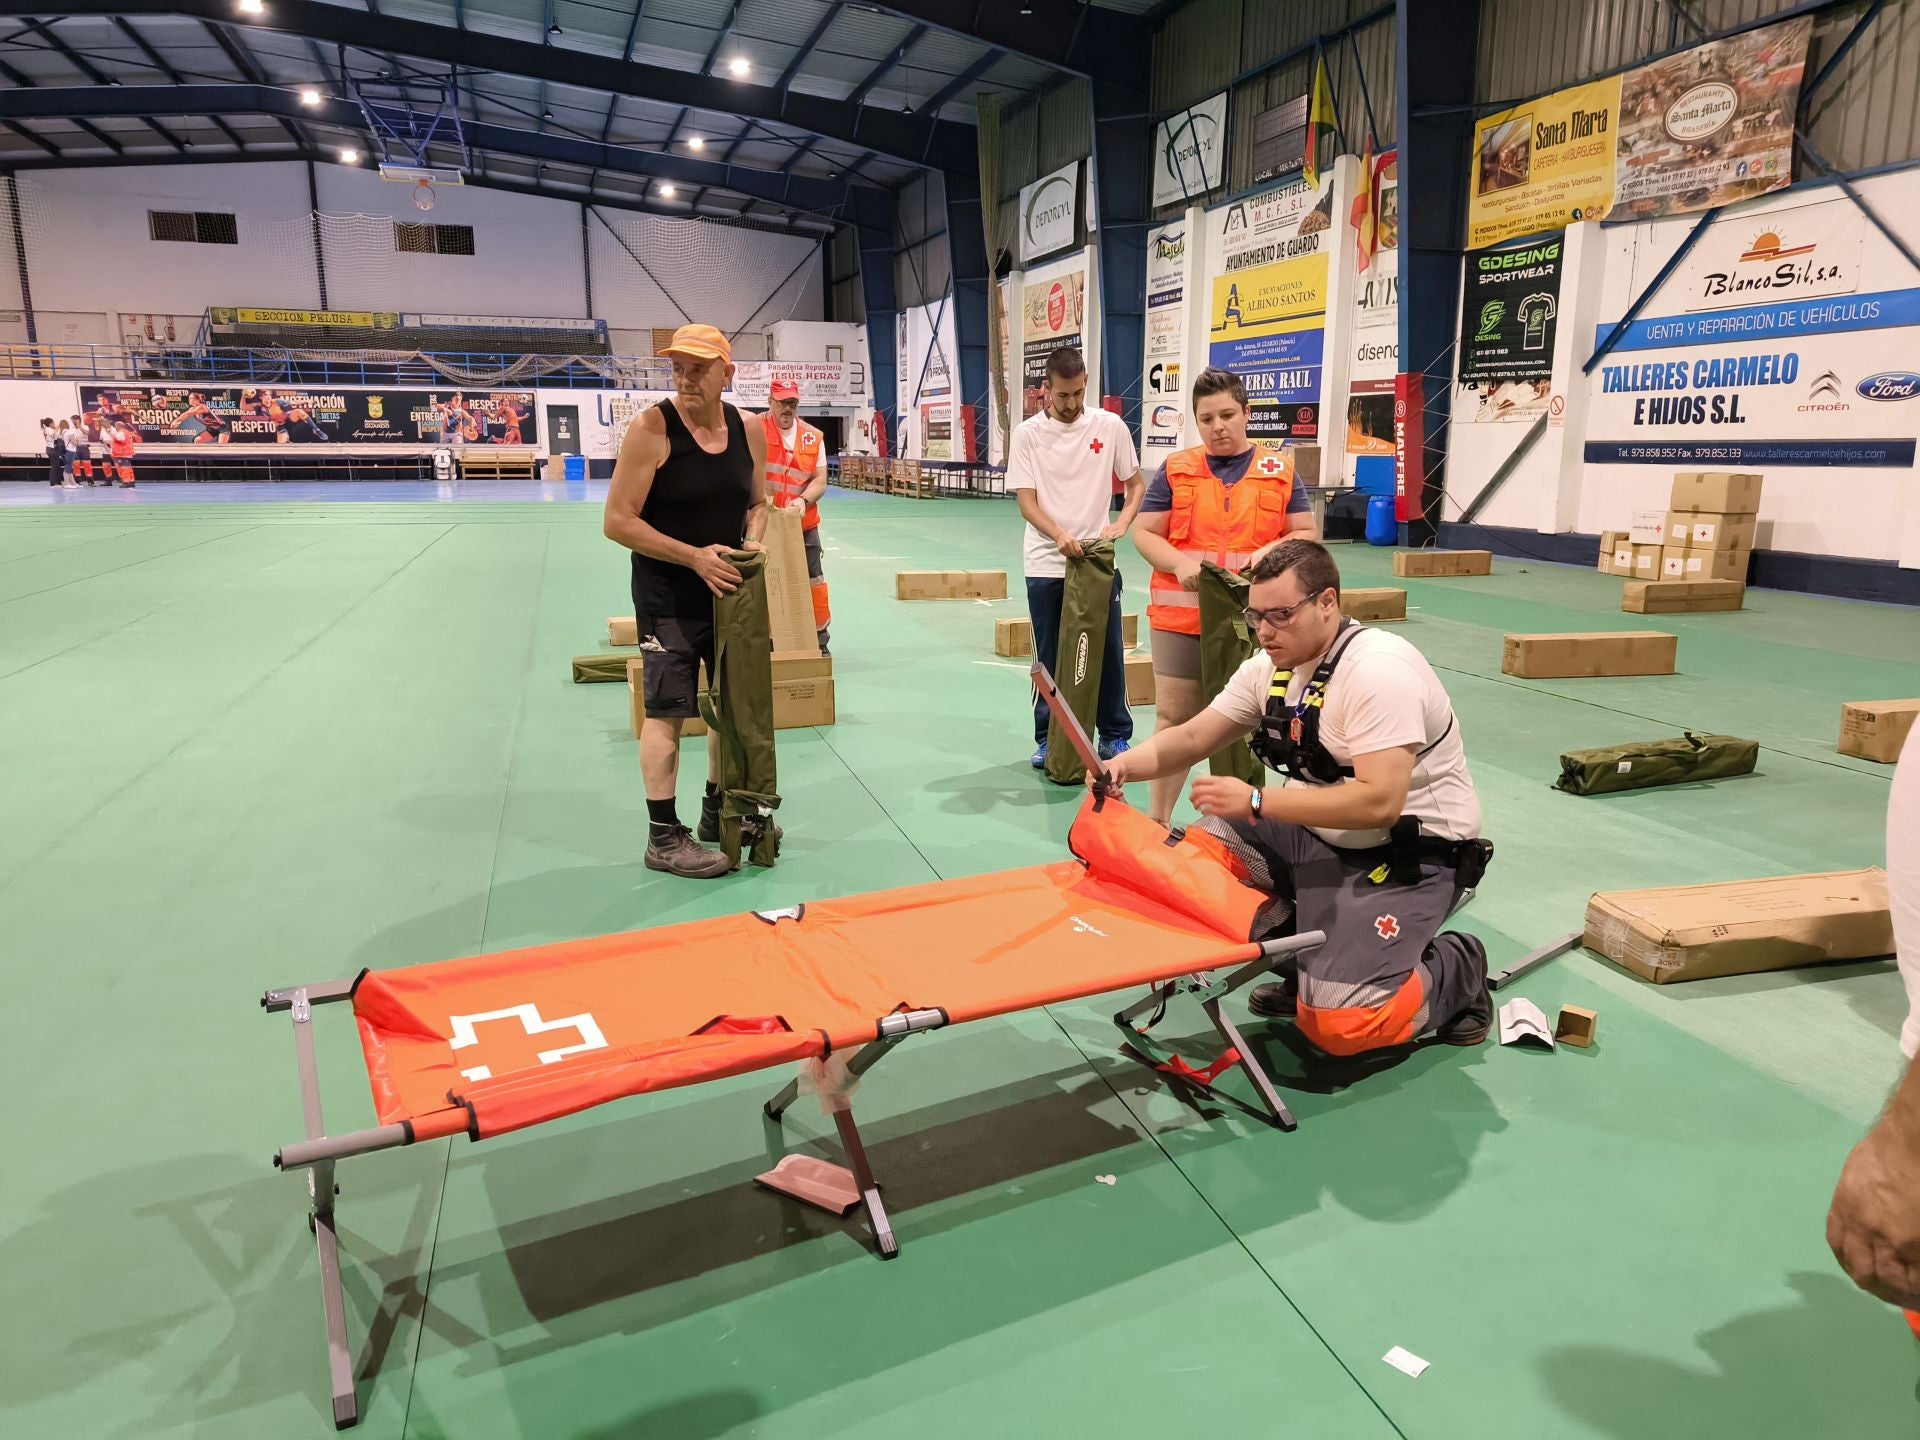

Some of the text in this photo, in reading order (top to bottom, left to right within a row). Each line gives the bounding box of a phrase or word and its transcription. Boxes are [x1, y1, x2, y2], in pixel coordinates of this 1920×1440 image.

[1679, 90, 1726, 108] RESTAURANTE
[1670, 100, 1731, 124] Santa Marta
[1536, 109, 1608, 150] Santa Marta
[1255, 168, 1273, 182] LOCAL
[1571, 175, 1602, 187] Variadas
[1250, 181, 1312, 209] COMBUSTIBLES
[1671, 180, 1696, 191] GUARDO
[1226, 244, 1275, 272] AYUNTAMIENTO
[1277, 242, 1285, 258] DE
[1287, 233, 1319, 256] GUARDO
[1479, 243, 1560, 270] GDESING
[1478, 264, 1554, 285] SPORTWEAR
[1259, 280, 1303, 296] EXCAVACIONES
[1247, 289, 1316, 312] ALBINO SANTOS
[255, 311, 353, 324] SECCION PELUSA
[1646, 301, 1881, 341] VENTA Y REPARACIÓN DE VEHÍCULOS
[771, 369, 802, 380] JESÚS
[1280, 370, 1312, 390] RAUL
[1602, 352, 1799, 394] TALLERES CARMELO
[1868, 376, 1914, 397] Ford
[206, 401, 236, 409] BALANCE
[469, 399, 500, 410] RESPET
[1633, 394, 1746, 426] E HIJOS S.L.
[410, 411, 444, 421] ENTREGA
[232, 421, 276, 433] RESPETO
[1263, 440, 1280, 449] HORAS
[1618, 448, 1630, 458] Tel.
[1677, 448, 1693, 459] Fax.
[1695, 448, 1742, 459] 979.852.133
[1742, 449, 1886, 460] www.tallerescarmeloehijos.com
[1396, 422, 1405, 496] MAPFRE
[1078, 636, 1087, 677] FERRINO
